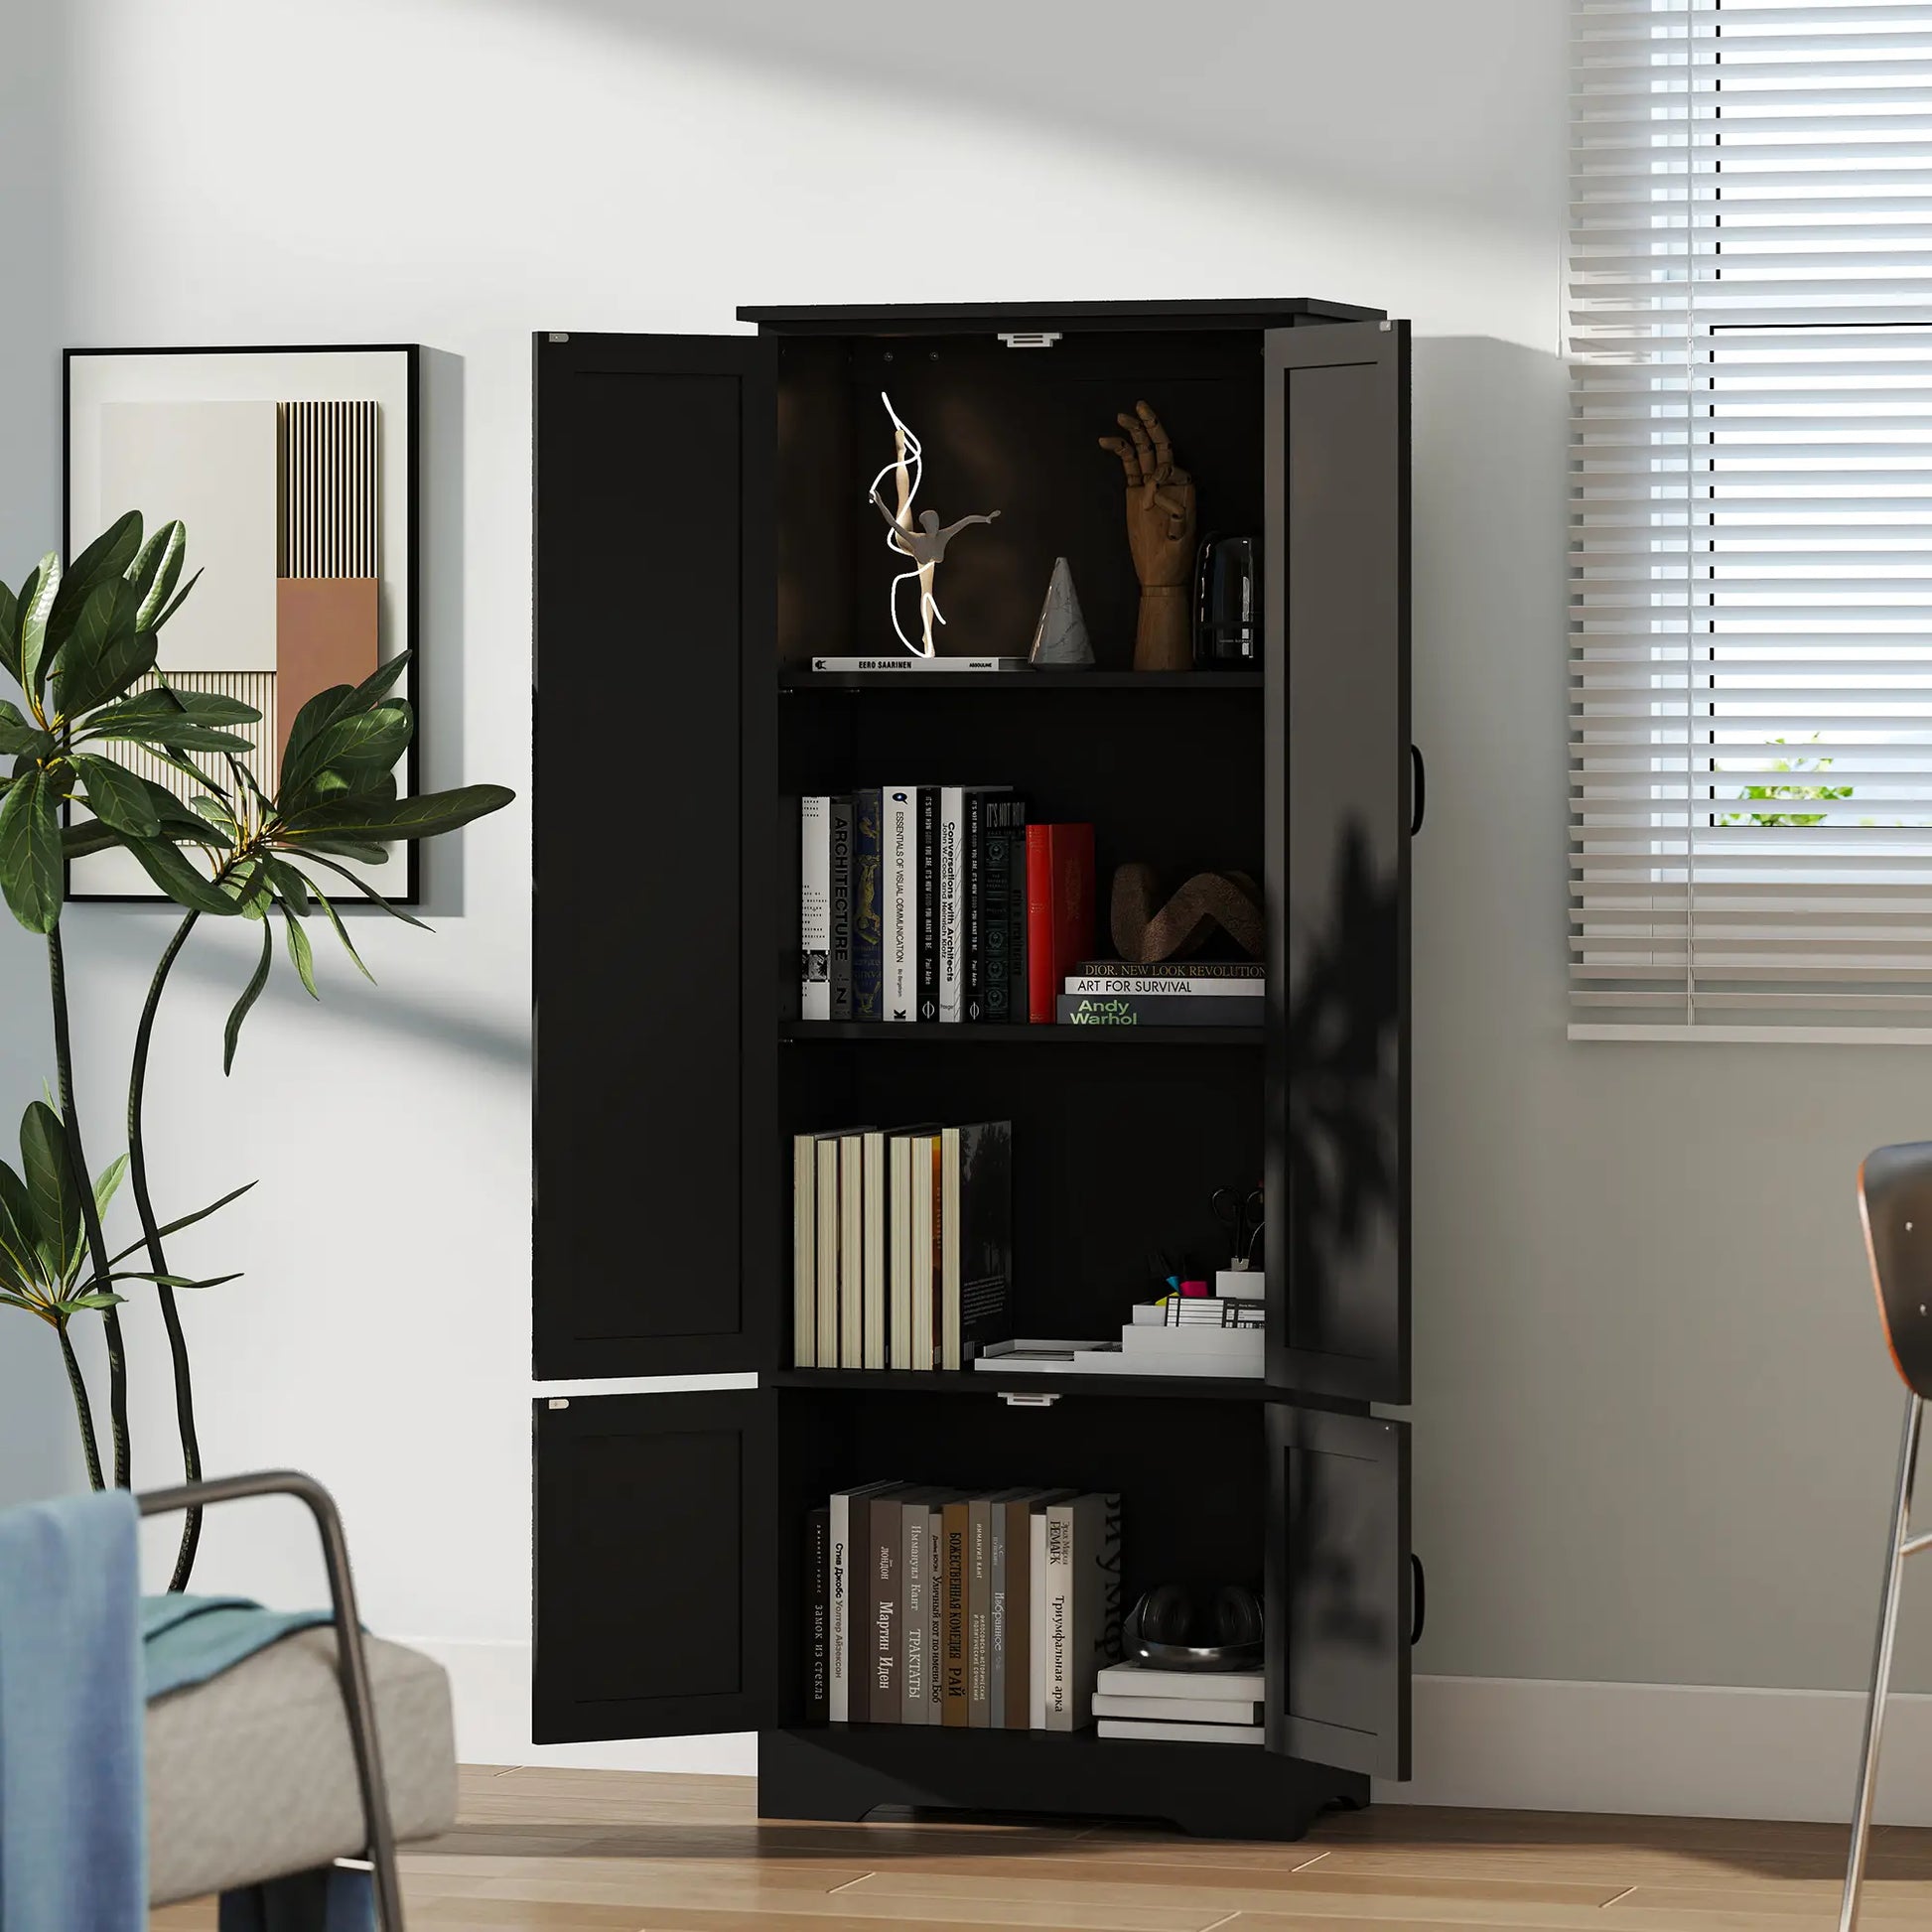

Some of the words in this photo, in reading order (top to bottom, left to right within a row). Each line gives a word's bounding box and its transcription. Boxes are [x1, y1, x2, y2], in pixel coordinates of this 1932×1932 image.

[896, 811, 904, 857] ESSENTIALS
[896, 858, 904, 869] OF
[835, 817, 848, 961] ARCHITECTURE
[896, 870, 904, 897] VISUAL
[896, 897, 904, 963] COMMUNICATION
[1078, 981, 1100, 991] ART
[1106, 981, 1130, 992] FOR
[1135, 981, 1191, 993] SURVIVAL
[1085, 965, 1118, 976] DIOR.
[1122, 965, 1152, 976] NEW
[1152, 965, 1186, 977] LOOK
[1070, 1013, 1138, 1025] Warhol
[1078, 999, 1130, 1015] Andy
[1050, 1521, 1060, 1565] РЕМАРК
[1060, 1521, 1070, 1539] Эрих
[909, 1525, 921, 1580] Иммануил
[1060, 1541, 1070, 1565] Мария
[834, 1567, 844, 1598] Джобс
[949, 1533, 961, 1608] БОЖЕСТВЕННАЯ
[911, 1584, 921, 1610] Кант
[933, 1577, 943, 1618] Уличный
[814, 1604, 823, 1639] замок
[834, 1600, 844, 1633] Уолтер
[877, 1601, 894, 1650] Мартин
[992, 1592, 1005, 1652] Избранное
[814, 1644, 823, 1658] из
[933, 1639, 939, 1651] по
[949, 1612, 961, 1659] КОМЕДИЯ
[1052, 1595, 1065, 1682] Триумфальная
[814, 1661, 823, 1700] стекла
[878, 1656, 894, 1690] Иден
[909, 1628, 921, 1700] ТРАКТАТЫ
[932, 1685, 943, 1704] Боб
[949, 1668, 965, 1697] РАЙ
[1052, 1686, 1063, 1713] арка
